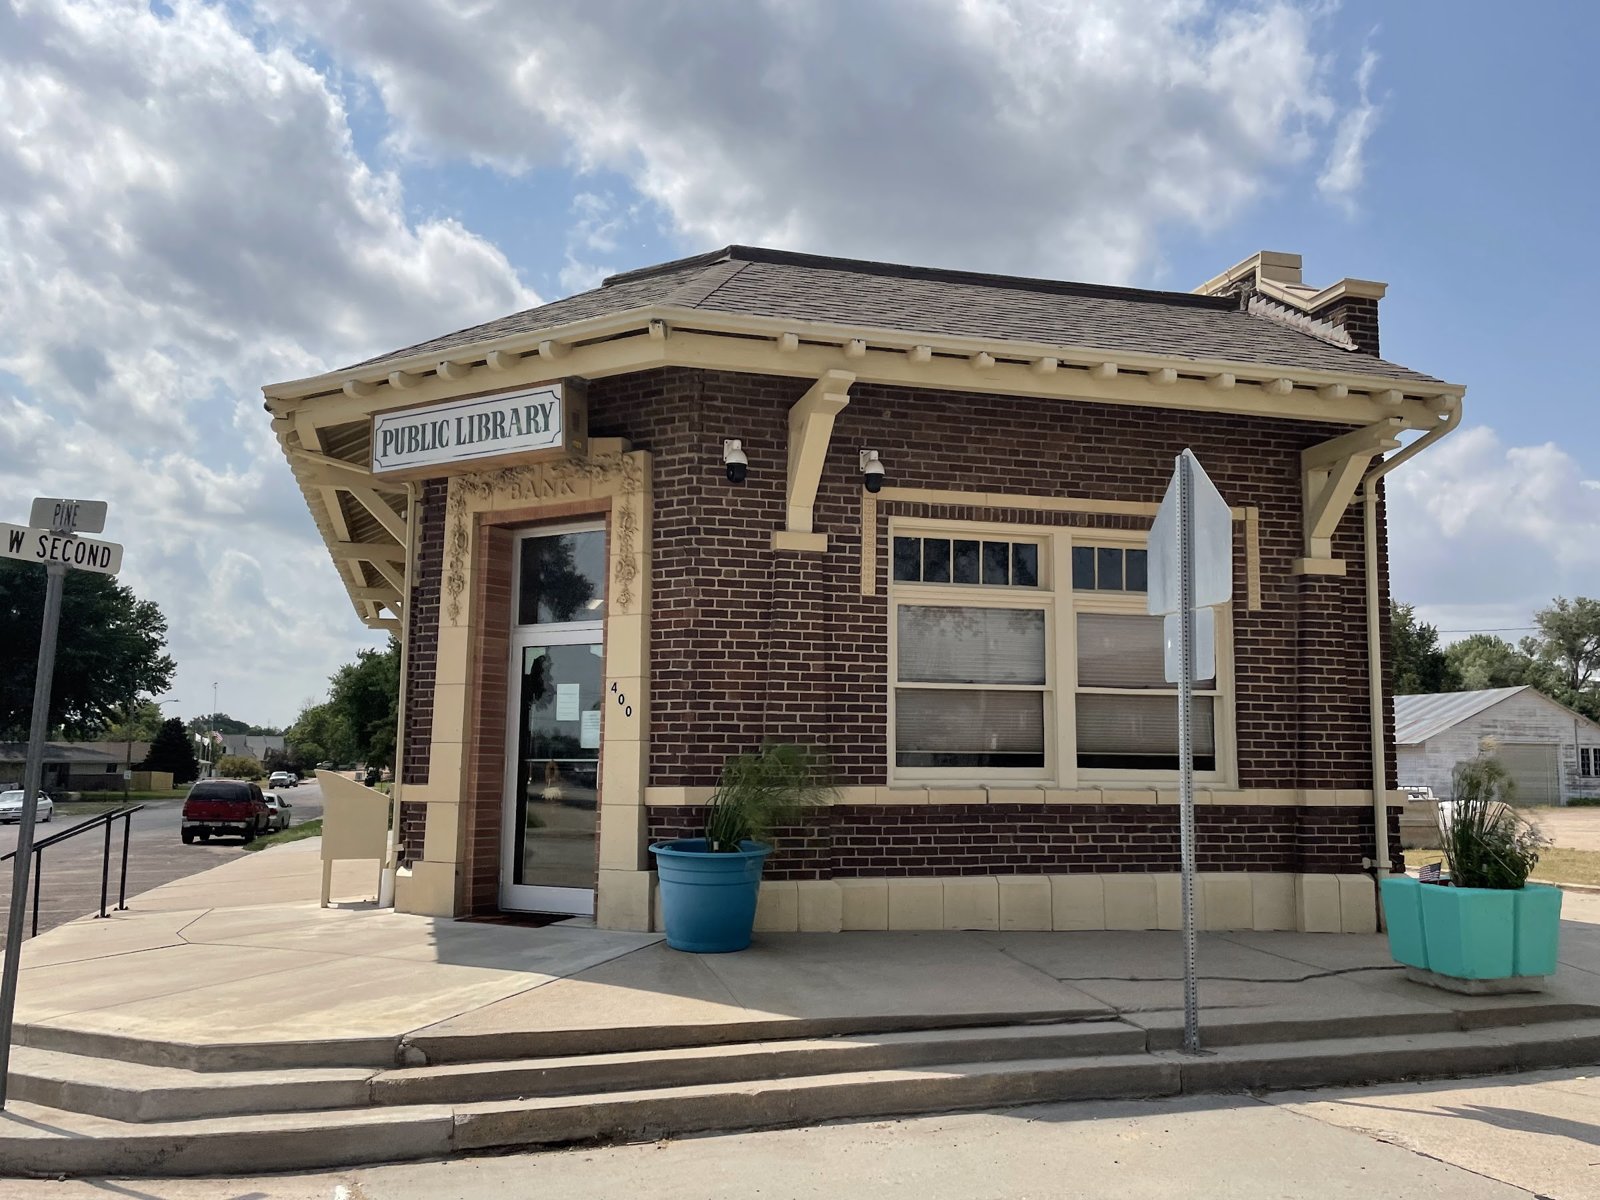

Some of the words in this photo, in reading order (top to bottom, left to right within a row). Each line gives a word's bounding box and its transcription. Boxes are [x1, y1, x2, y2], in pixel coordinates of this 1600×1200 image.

[381, 419, 450, 458] PUBLIC
[454, 402, 555, 447] LIBRARY
[511, 479, 576, 500] BANK
[53, 503, 80, 527] PINE
[9, 529, 25, 554] W
[36, 535, 111, 568] SECOND
[611, 682, 632, 717] 400
